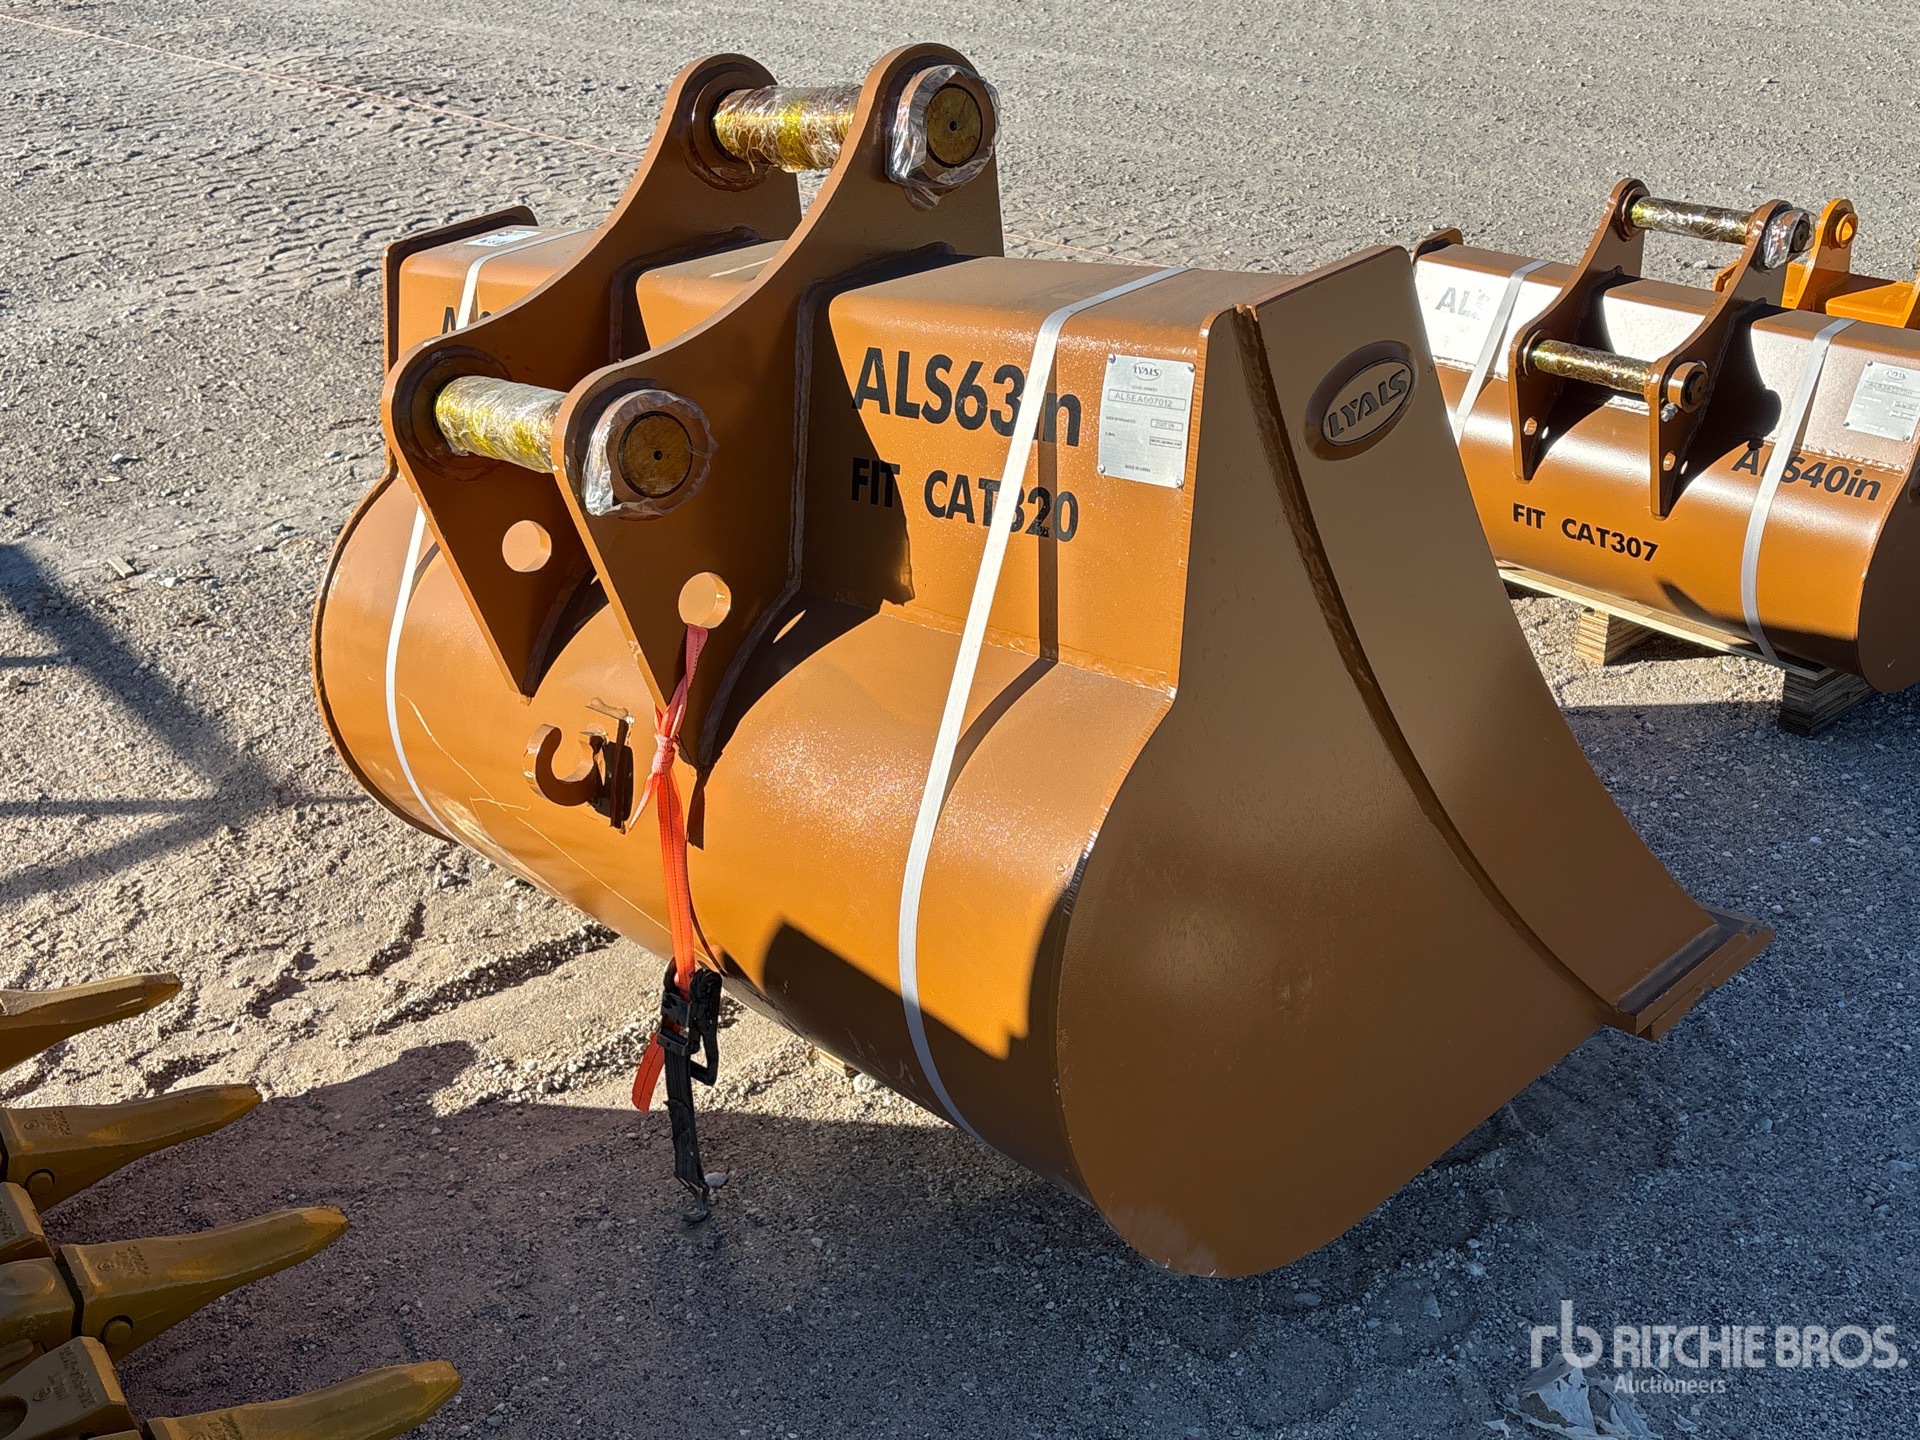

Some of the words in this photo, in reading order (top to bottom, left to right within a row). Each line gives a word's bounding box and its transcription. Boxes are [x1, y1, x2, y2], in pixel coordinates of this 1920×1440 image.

[1328, 368, 1407, 438] LYALS
[851, 456, 901, 509] FIT
[1731, 449, 1882, 502] AS40in
[1512, 502, 1546, 530] FIT
[1561, 517, 1660, 563] CAT307
